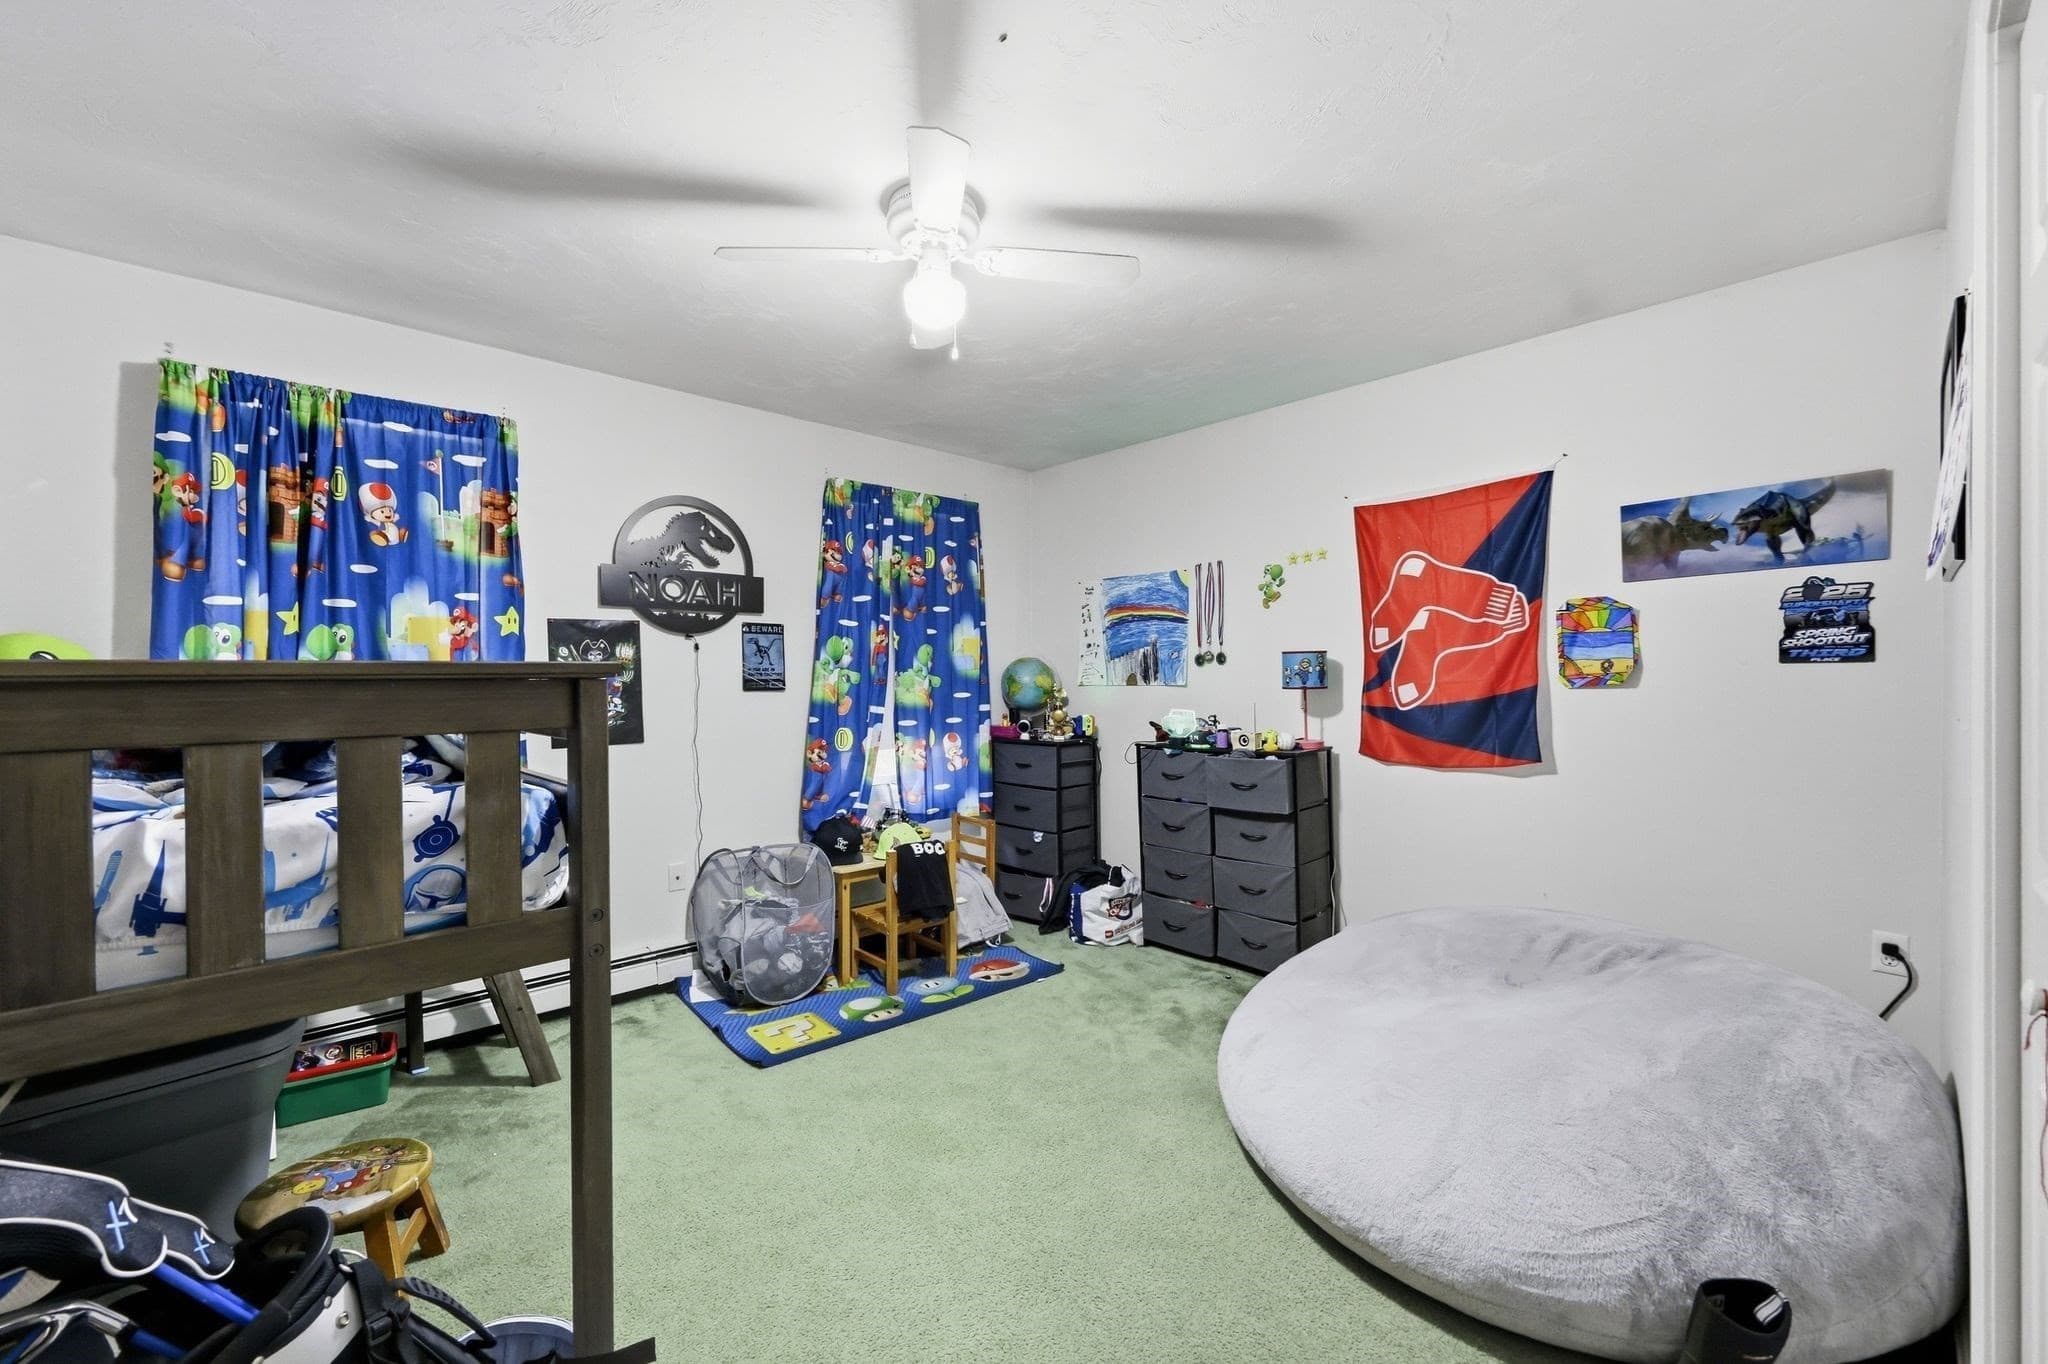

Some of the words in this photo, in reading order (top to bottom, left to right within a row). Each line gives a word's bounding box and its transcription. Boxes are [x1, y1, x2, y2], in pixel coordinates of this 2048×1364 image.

[628, 571, 741, 607] NOAH
[1782, 583, 1870, 601] 225
[751, 625, 784, 633] BEWARE
[1794, 626, 1857, 639] SPRING
[1782, 633, 1871, 648] SHOOTOUT
[1789, 648, 1867, 657] THIRD
